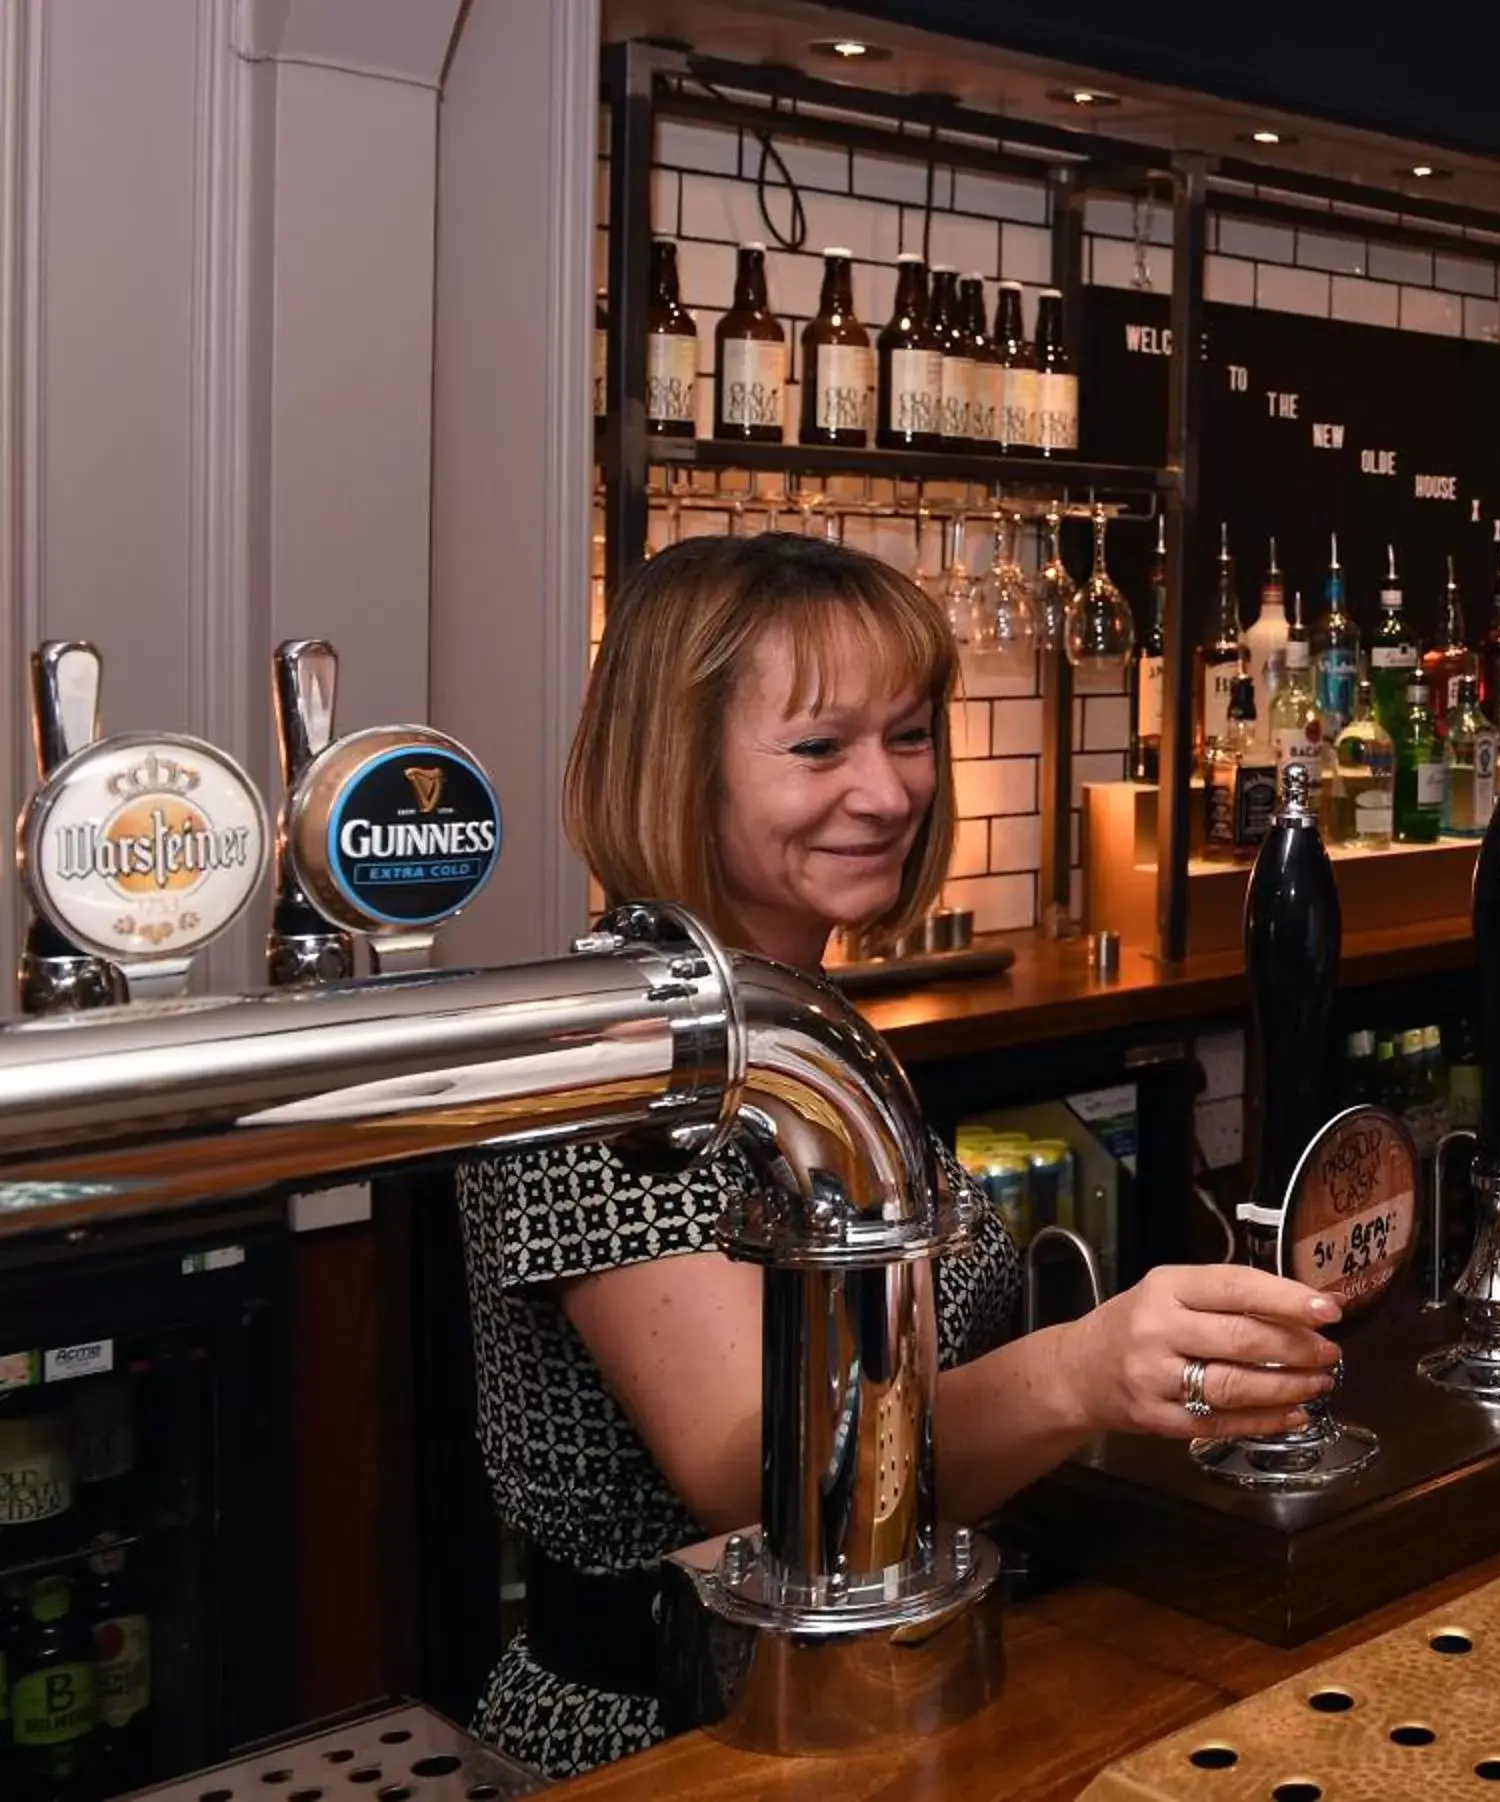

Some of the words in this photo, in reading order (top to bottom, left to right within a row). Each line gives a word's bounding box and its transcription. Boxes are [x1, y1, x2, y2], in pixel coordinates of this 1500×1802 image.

[1229, 365, 1248, 391] TO
[1268, 391, 1299, 419] THE
[1313, 423, 1345, 449] NEW
[1361, 450, 1397, 476] OLDE
[1415, 475, 1458, 501] HOUSE
[55, 808, 249, 890] Warsteiner
[340, 818, 495, 859] GUINNESS
[369, 866, 425, 880] EXTRA
[430, 863, 471, 877] COLD
[46, 1674, 75, 1714] B
